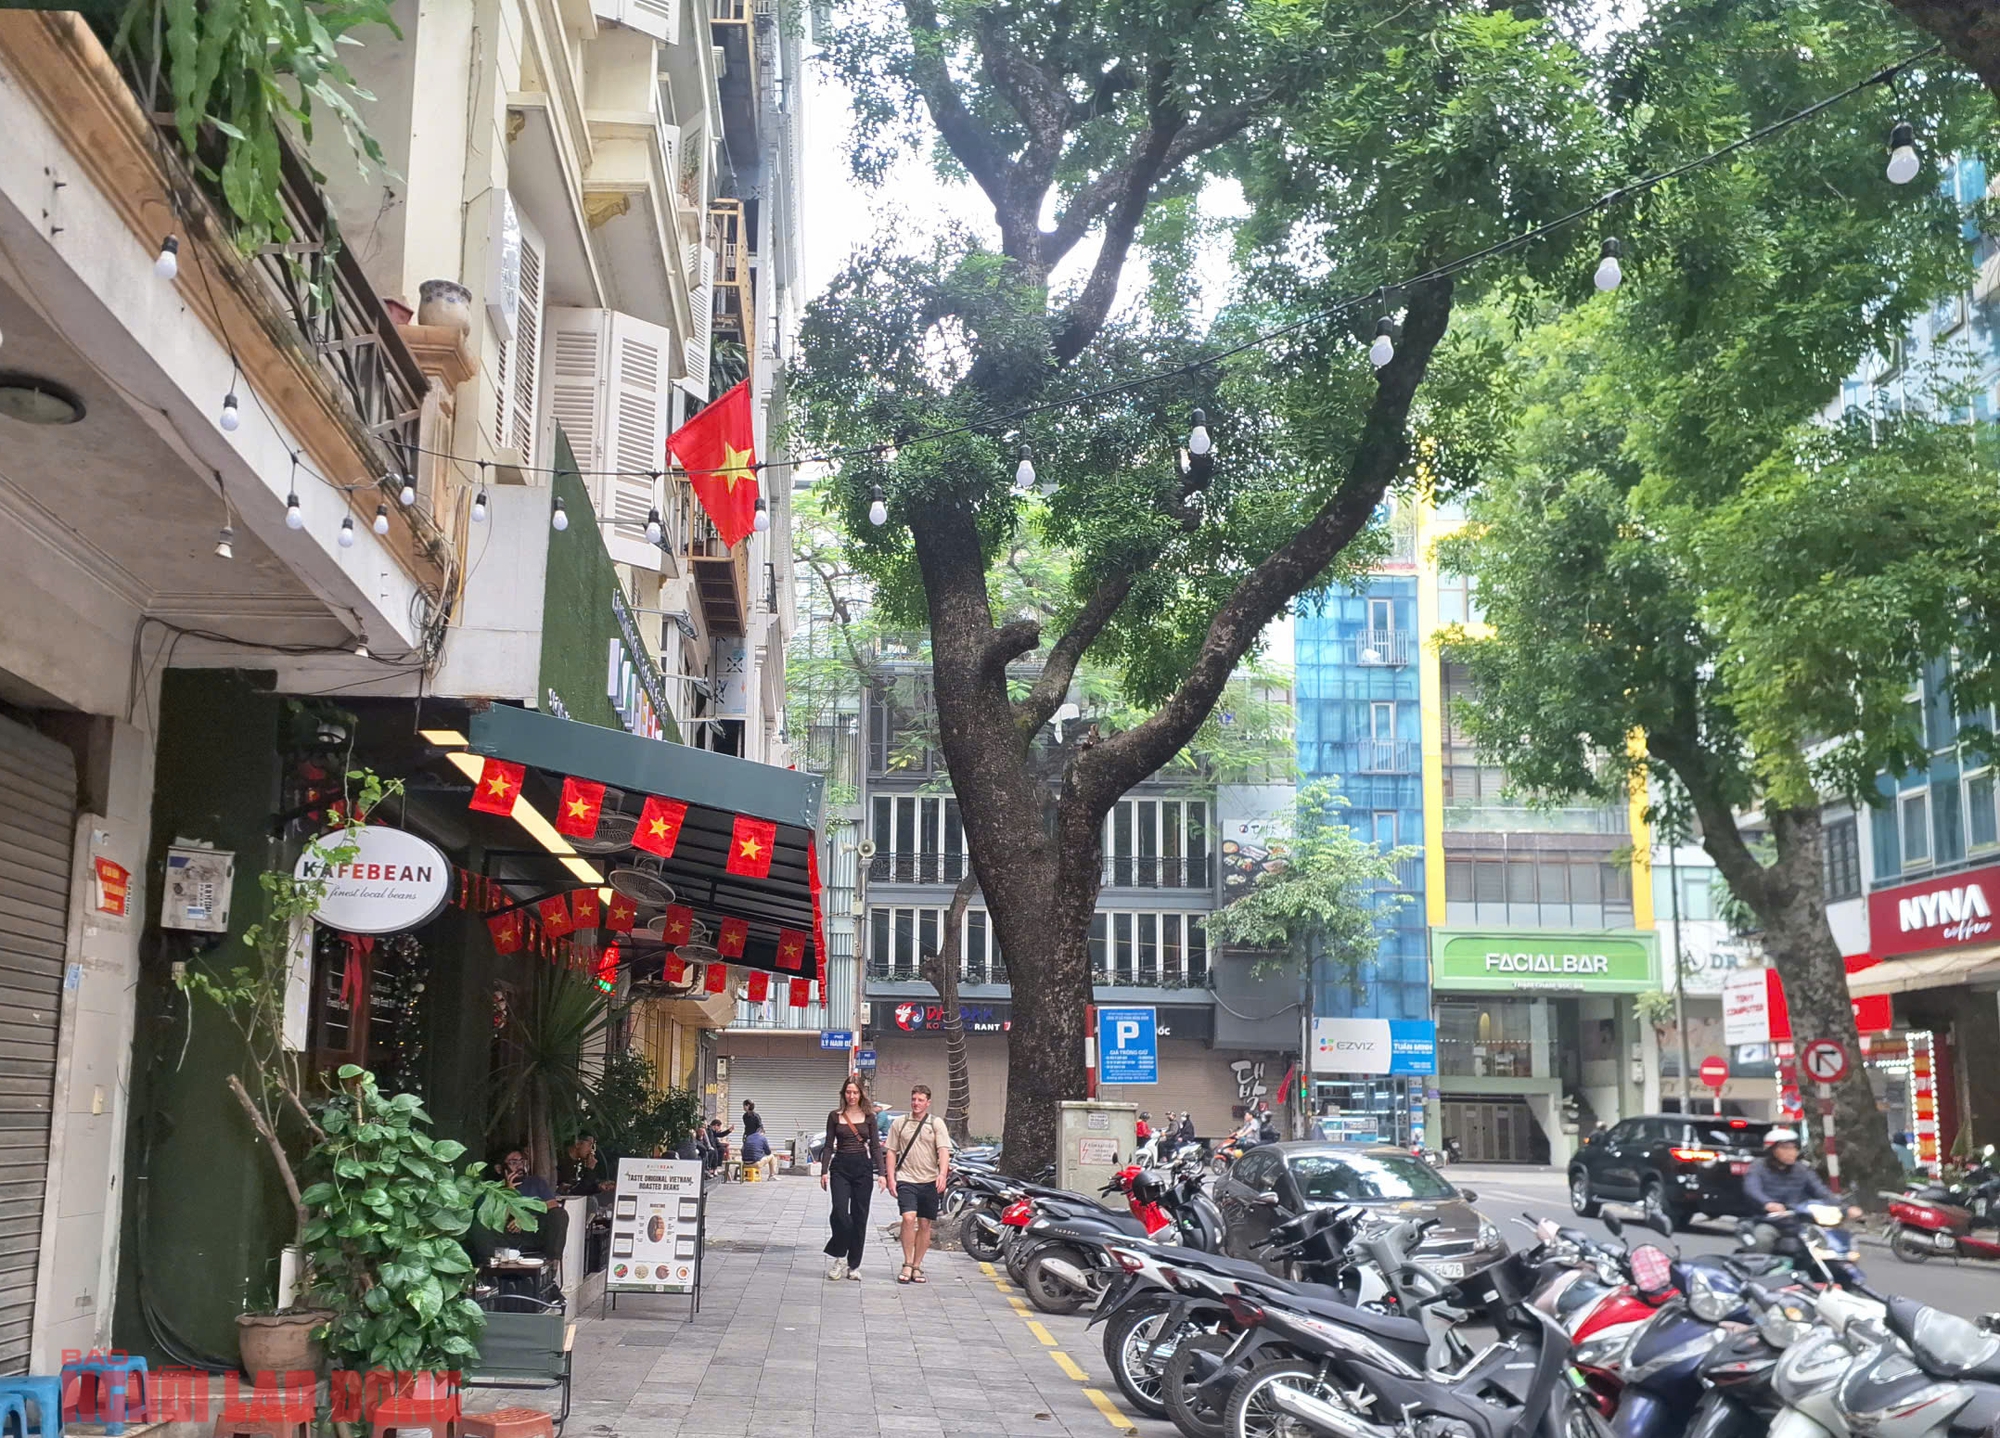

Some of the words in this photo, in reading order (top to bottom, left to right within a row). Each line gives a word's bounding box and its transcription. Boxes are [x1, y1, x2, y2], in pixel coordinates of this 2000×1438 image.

[303, 861, 432, 883] KAFEBEAN
[328, 885, 358, 900] finest
[360, 887, 386, 899] local
[388, 887, 417, 900] beans
[1117, 1021, 1140, 1049] P
[1336, 1041, 1376, 1051] EZVIZ
[628, 1174, 643, 1182] TASTE
[645, 1175, 668, 1183] ORIGINAL
